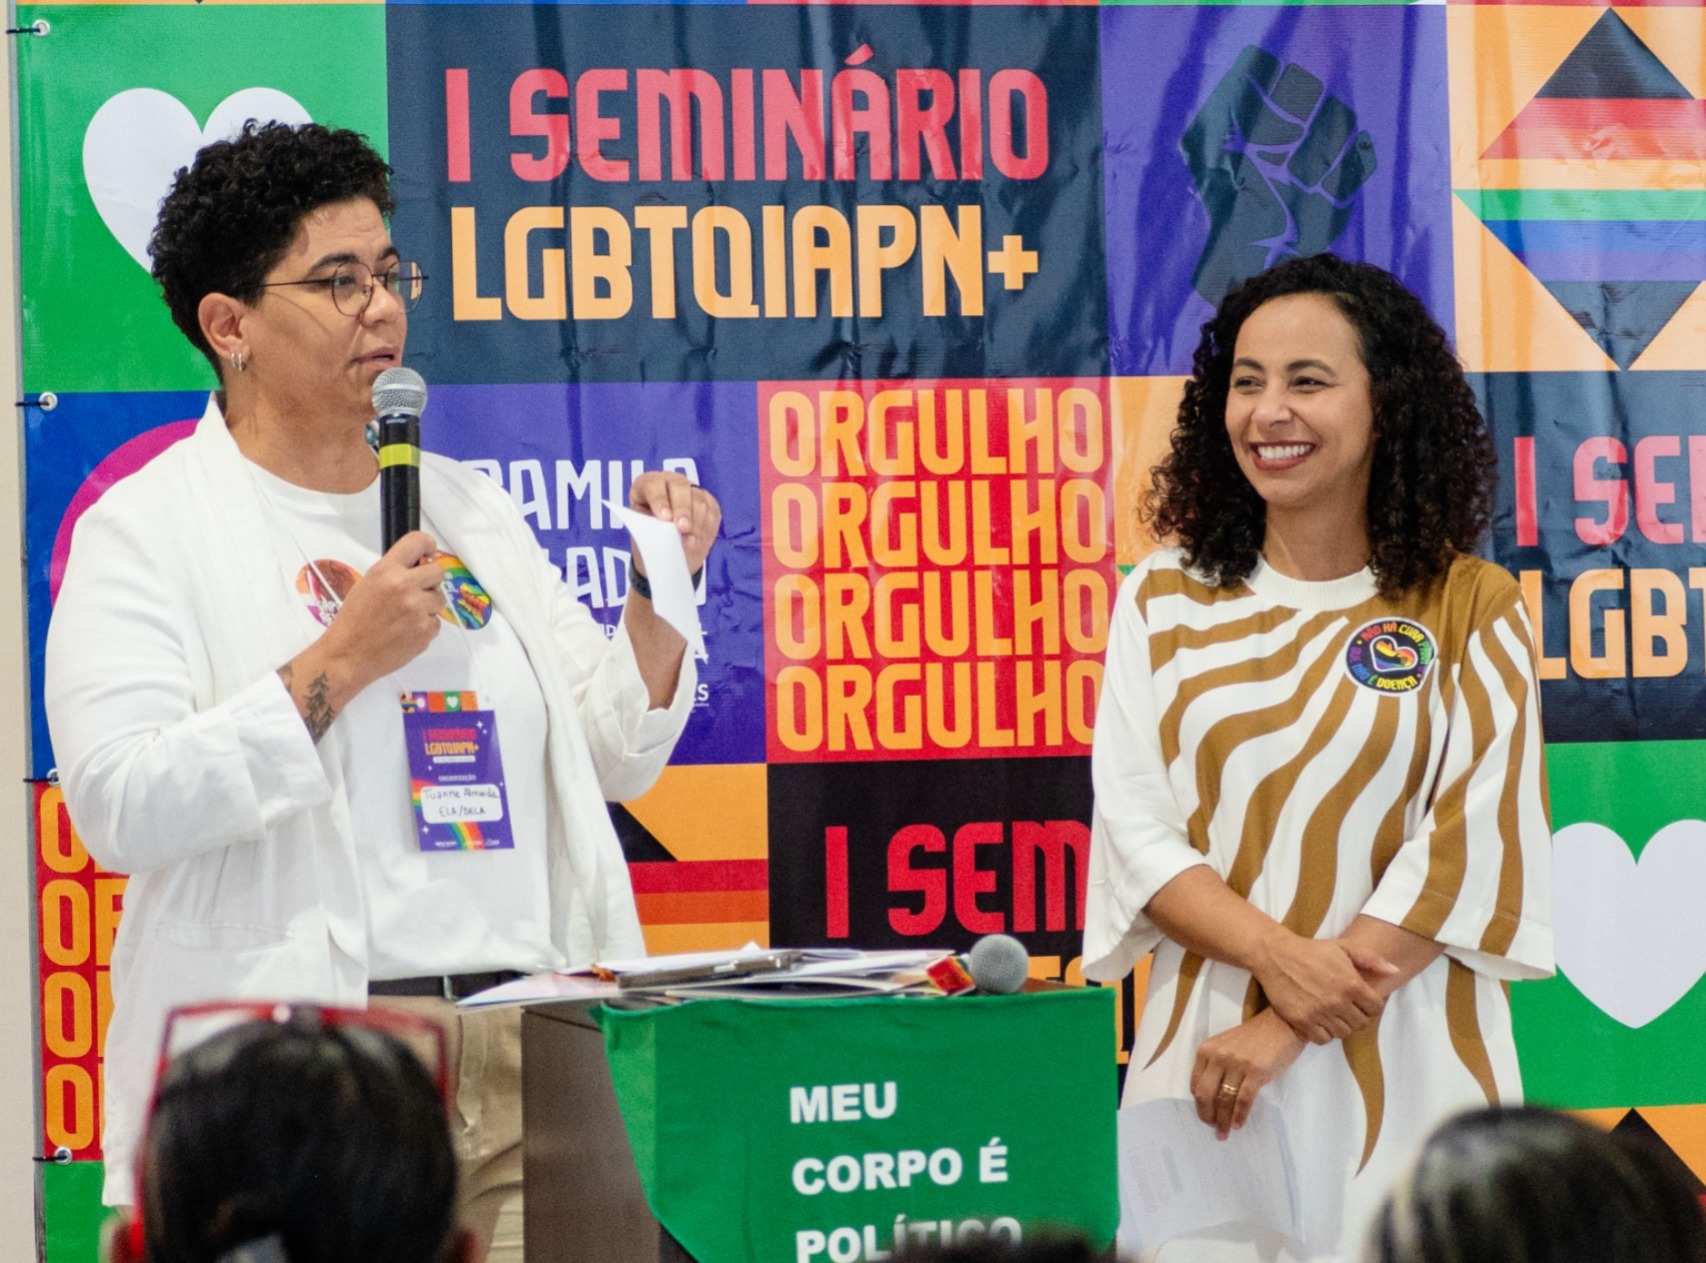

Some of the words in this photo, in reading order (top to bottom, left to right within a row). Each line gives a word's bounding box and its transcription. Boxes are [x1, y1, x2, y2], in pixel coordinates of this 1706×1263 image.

[446, 68, 471, 183] I
[509, 43, 1050, 183] SEMINÁRIO
[450, 205, 1040, 321] LGBTQIAPN+
[769, 387, 1104, 477] ORGULHO
[771, 478, 1107, 569] ORGULHO
[1514, 436, 1539, 547] I
[774, 568, 1109, 660] ORGULHO
[1399, 624, 1425, 643] CURA
[776, 659, 1105, 752] ORGULHO
[1377, 675, 1418, 691] DOENÇA
[825, 826, 849, 938] I
[790, 1081, 898, 1123] MEU
[792, 1148, 963, 1195] CORPO
[979, 1137, 1009, 1182] É
